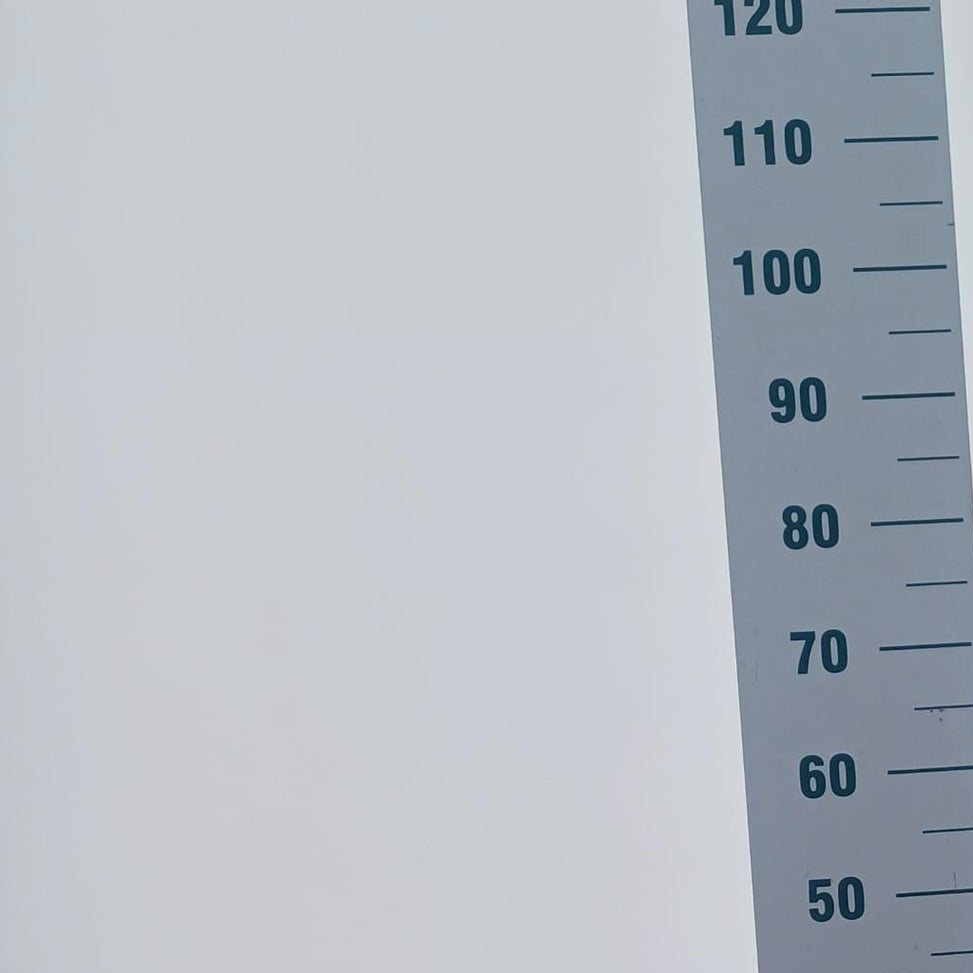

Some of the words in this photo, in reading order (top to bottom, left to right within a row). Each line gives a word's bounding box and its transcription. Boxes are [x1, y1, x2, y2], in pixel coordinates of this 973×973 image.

[714, 0, 803, 36] 120
[724, 119, 812, 166] 110
[733, 249, 821, 295] 100
[769, 377, 827, 423] 90
[782, 504, 839, 550] 80
[790, 629, 848, 674] 70
[799, 753, 856, 799] 60
[809, 877, 865, 922] 50
